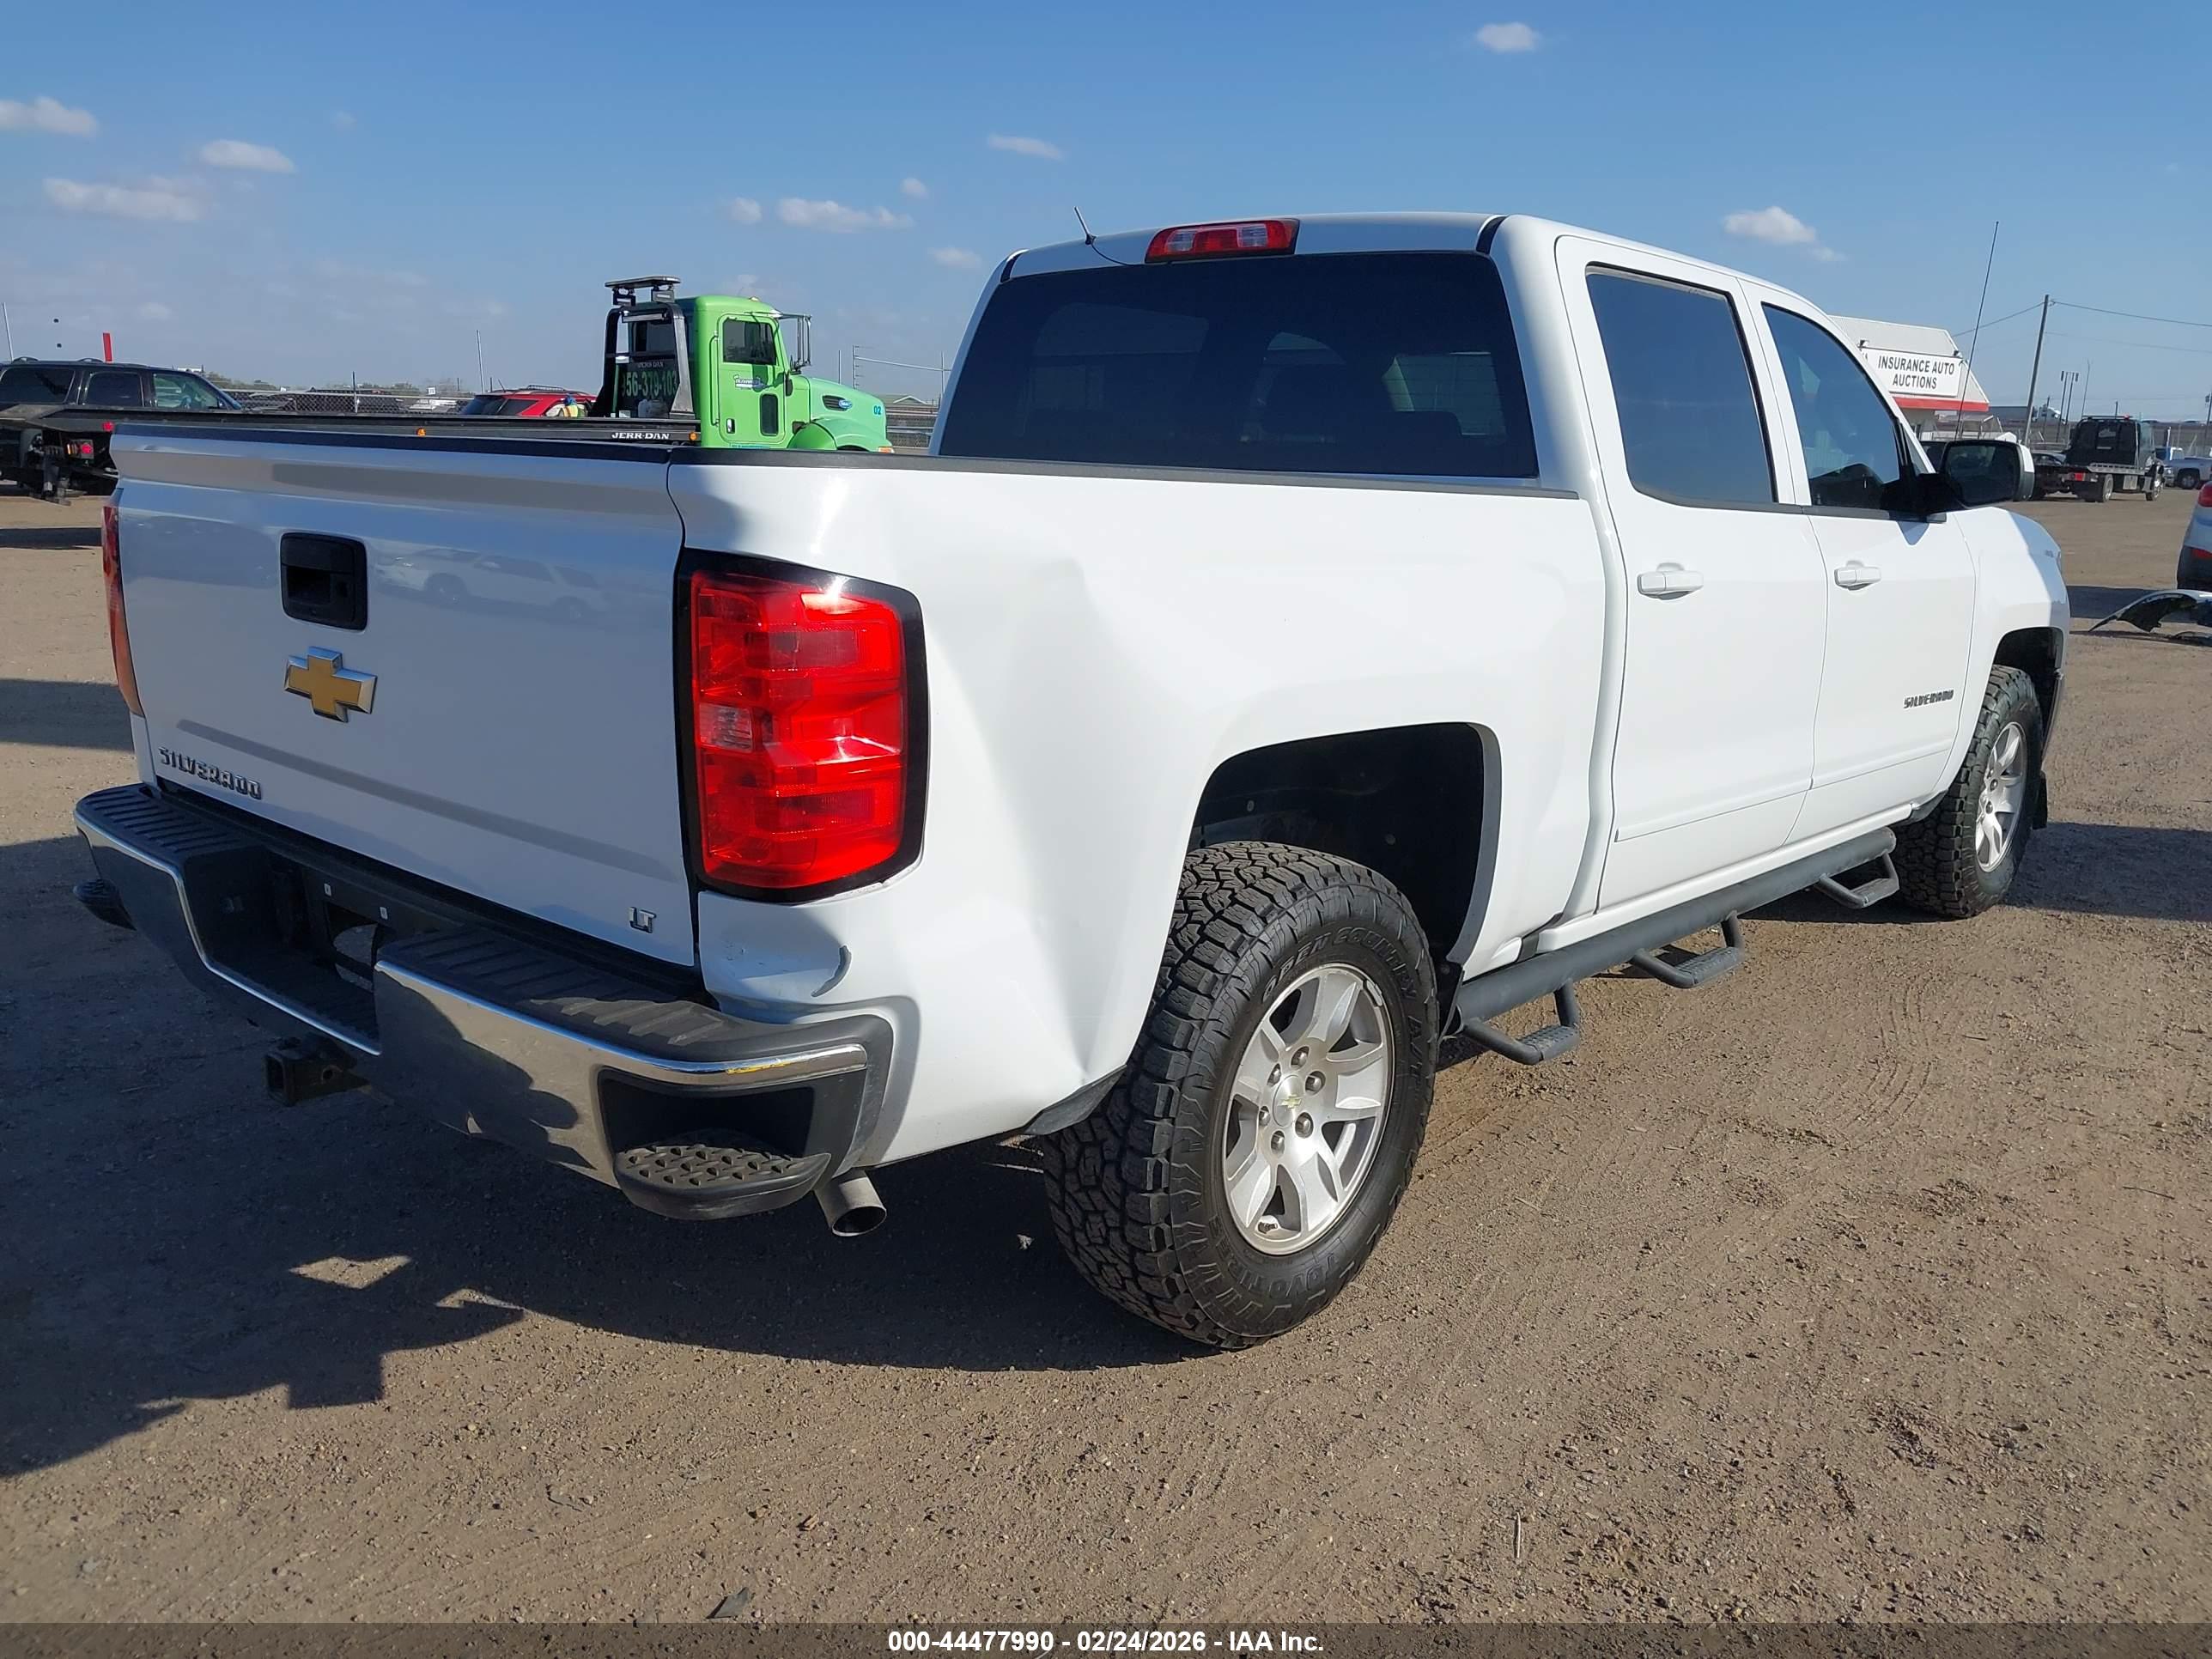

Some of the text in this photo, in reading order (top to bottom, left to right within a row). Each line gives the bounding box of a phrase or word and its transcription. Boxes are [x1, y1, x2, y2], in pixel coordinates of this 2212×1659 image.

[1877, 355, 1954, 376] INSURANCE AUTO
[1893, 373, 1938, 390] AUCTIONS
[873, 405, 882, 415] 02
[158, 746, 264, 800] SILVERADO
[628, 906, 657, 934] LT
